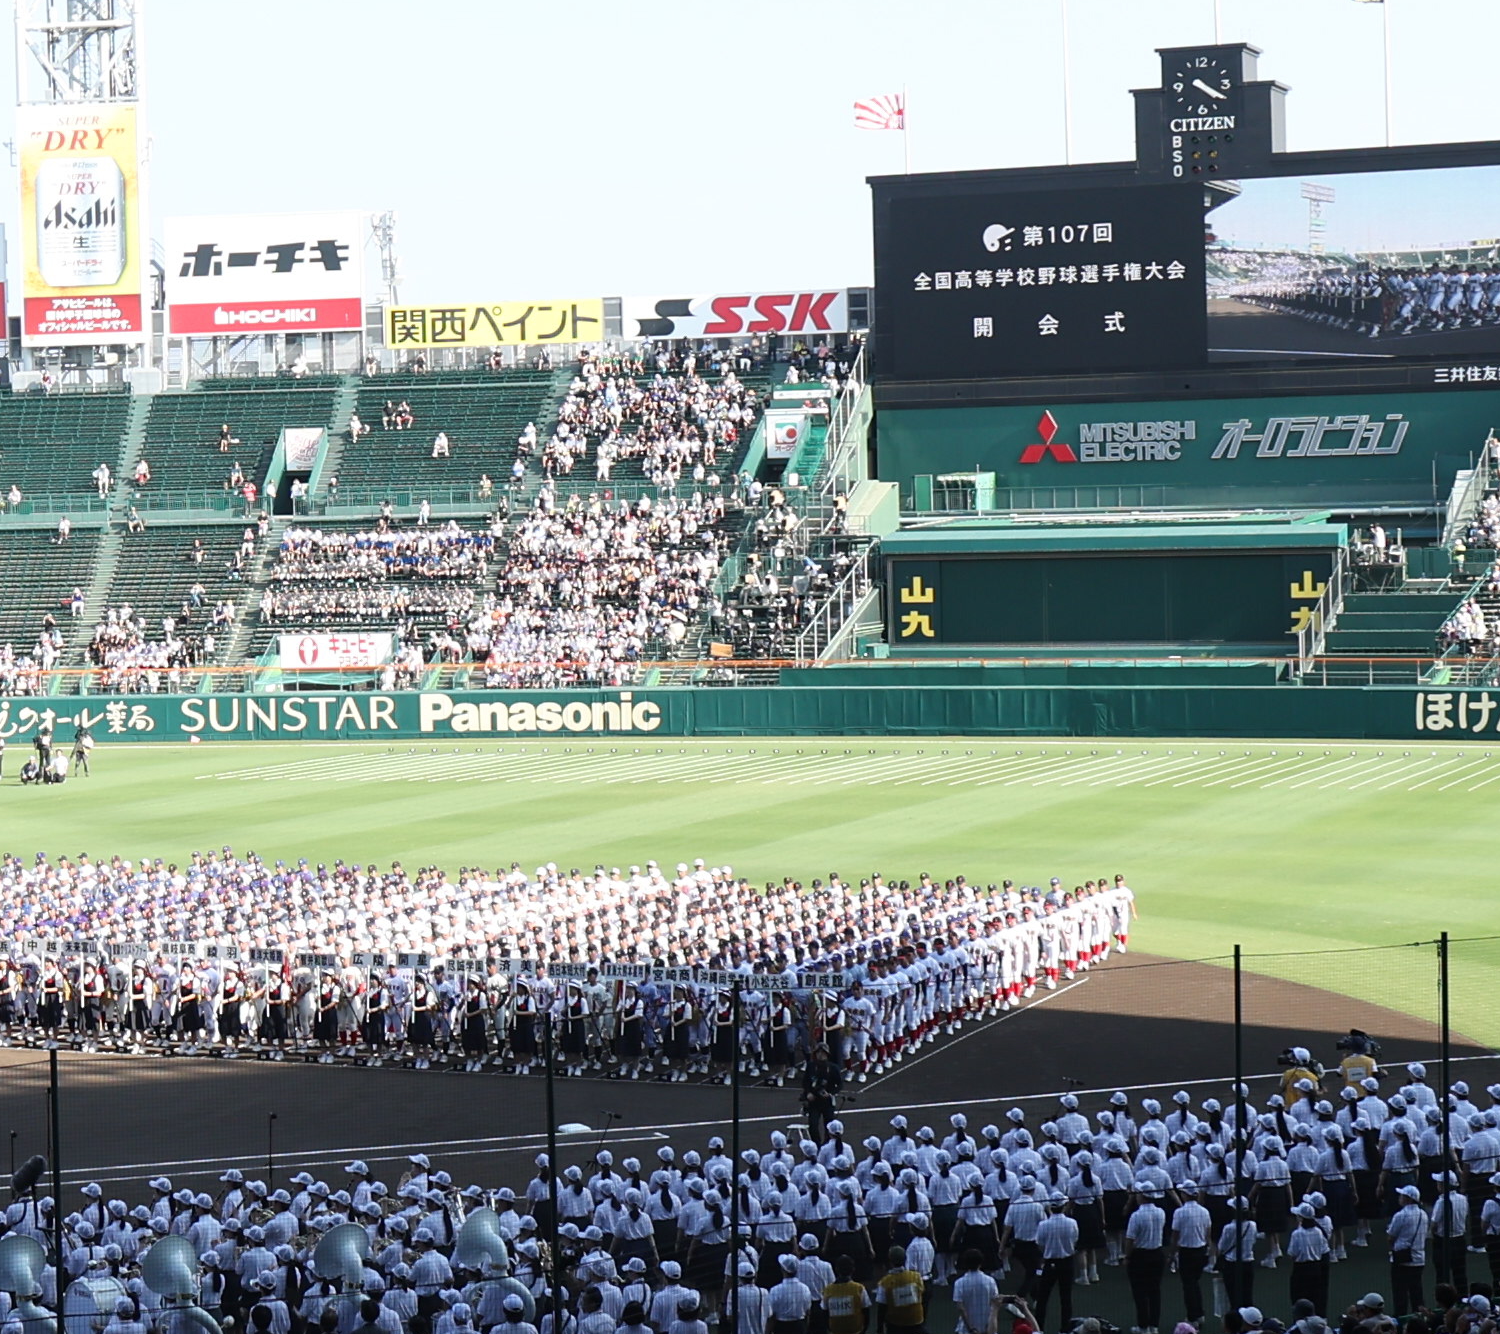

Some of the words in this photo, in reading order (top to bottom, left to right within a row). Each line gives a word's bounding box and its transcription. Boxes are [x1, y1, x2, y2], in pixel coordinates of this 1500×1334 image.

[1195, 56, 1208, 68] 12
[1172, 82, 1184, 94] 9
[1220, 79, 1232, 90] 3
[1197, 104, 1209, 115] 6
[58, 116, 100, 125] SUPER
[1170, 115, 1236, 133] CITIZEN
[1172, 135, 1183, 148] B
[1172, 150, 1183, 163] S
[1173, 164, 1184, 177] O
[43, 197, 116, 230] Asahi
[73, 235, 90, 248] 生
[1022, 222, 1113, 248] 第107回
[179, 239, 349, 277] ホーチキ
[913, 259, 1187, 292] 全国高等学校野球選手権大会
[229, 307, 316, 324] HOCHIKI
[703, 291, 839, 335] SSK
[391, 305, 599, 345] 関西ペイント
[1079, 420, 1196, 442] MITSUBISHI
[1211, 413, 1409, 460] オーロラビジョン
[1080, 441, 1182, 462] ELECTRIC
[901, 576, 935, 639] 山九
[329, 633, 375, 654] キューピー
[20, 700, 156, 734] クオール薬局
[180, 696, 398, 733] SUNSTAR
[420, 692, 662, 733] Panasonic
[27, 940, 58, 953] 中越
[64, 942, 97, 954] 未来富山
[161, 943, 196, 955] 県岐阜商
[352, 954, 385, 967] 広陵
[398, 954, 428, 966] 開星
[498, 960, 533, 973] 済美
[653, 968, 691, 982] 宮崎商
[804, 973, 844, 987] 創成館
